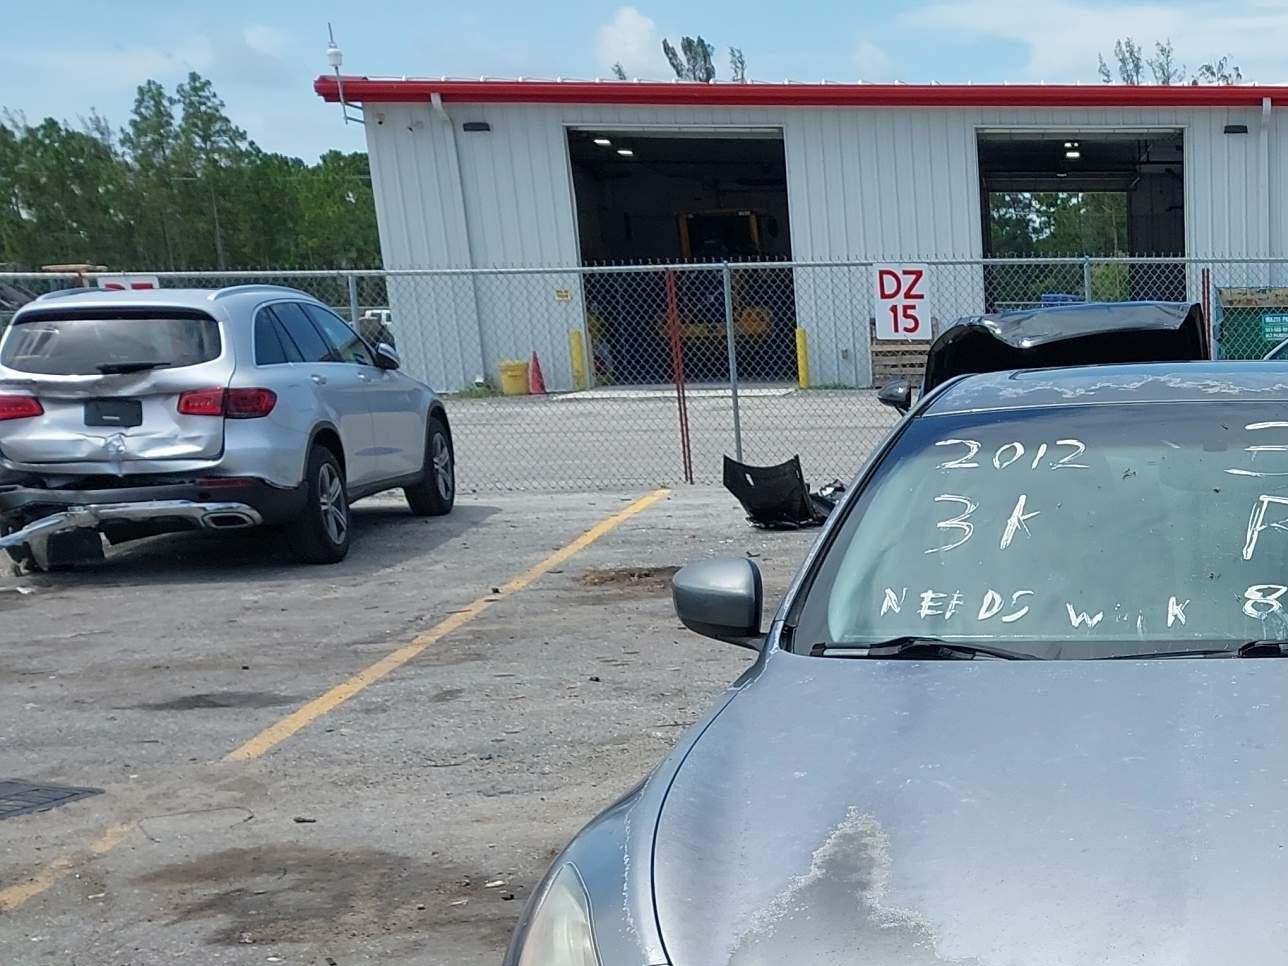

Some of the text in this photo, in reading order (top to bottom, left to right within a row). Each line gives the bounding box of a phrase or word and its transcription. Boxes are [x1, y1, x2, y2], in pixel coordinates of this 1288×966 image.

[878, 269, 925, 300] DZ
[889, 304, 920, 334] 15
[935, 439, 1089, 470] 2012
